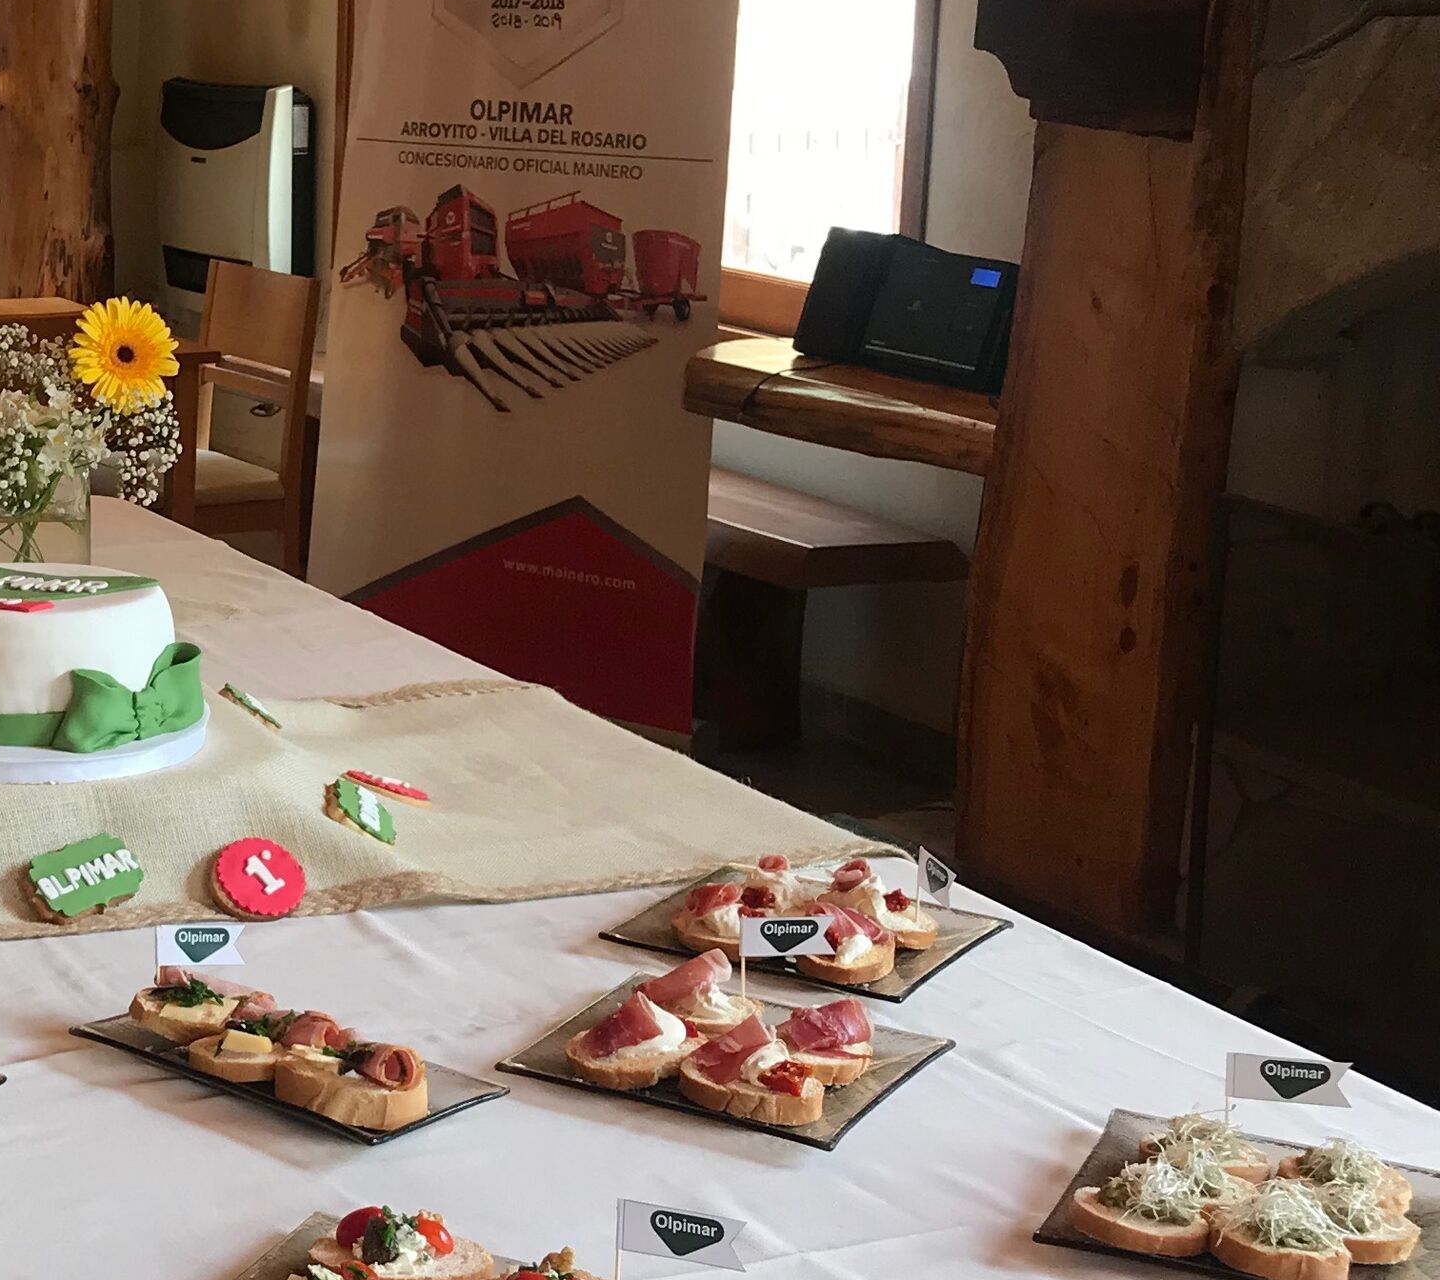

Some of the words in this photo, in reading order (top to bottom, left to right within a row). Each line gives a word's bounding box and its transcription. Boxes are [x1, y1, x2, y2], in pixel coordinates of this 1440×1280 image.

[470, 99, 573, 125] OLPIMAR
[401, 121, 477, 140] ARROYITO
[489, 126, 533, 143] VILLA
[537, 128, 566, 146] DEL
[571, 131, 647, 150] ROSARIO
[398, 150, 508, 171] CONCESIONARIO
[513, 157, 569, 174] OFICIAL
[573, 161, 643, 180] MAINERO
[503, 559, 636, 590] www.mainero.com
[37, 848, 139, 900] OLPIMAR
[178, 929, 225, 946] Olpimar
[763, 923, 814, 937] Olpimar
[1264, 1063, 1325, 1081] Olpimar
[654, 1213, 718, 1238] Olpimar
